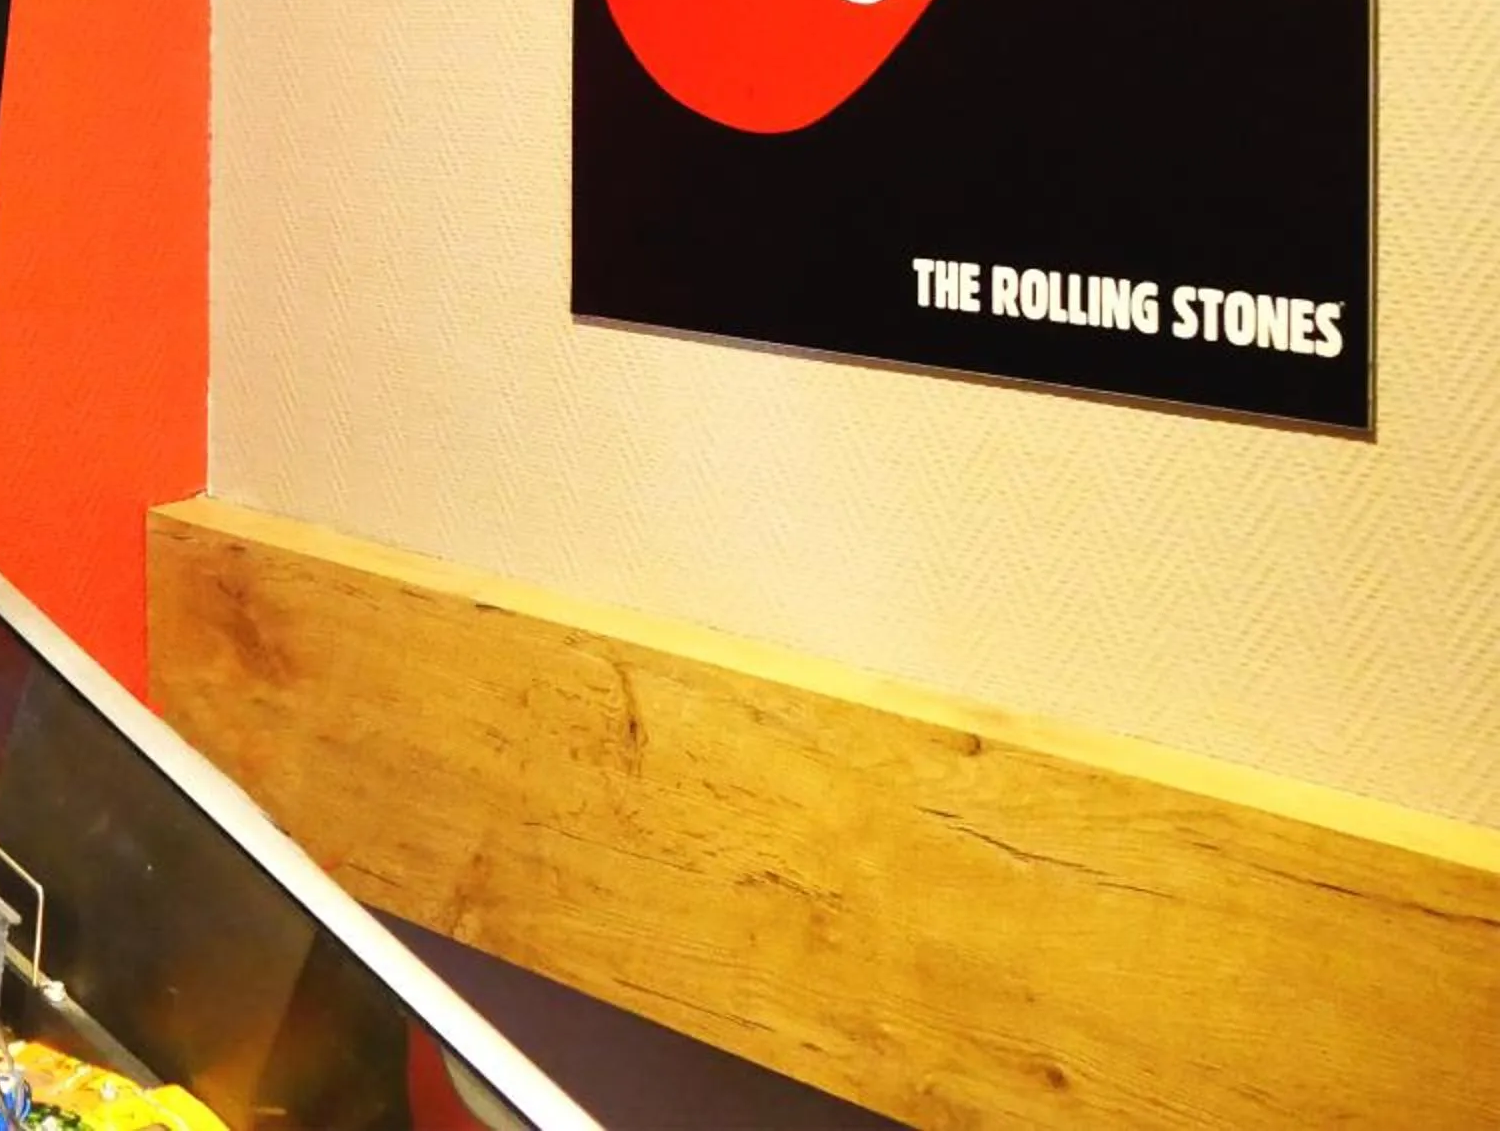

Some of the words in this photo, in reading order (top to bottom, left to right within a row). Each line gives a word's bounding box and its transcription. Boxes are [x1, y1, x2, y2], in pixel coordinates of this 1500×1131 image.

[913, 258, 980, 312] THE
[991, 265, 1160, 334] ROLLING
[1171, 286, 1344, 359] STONES
